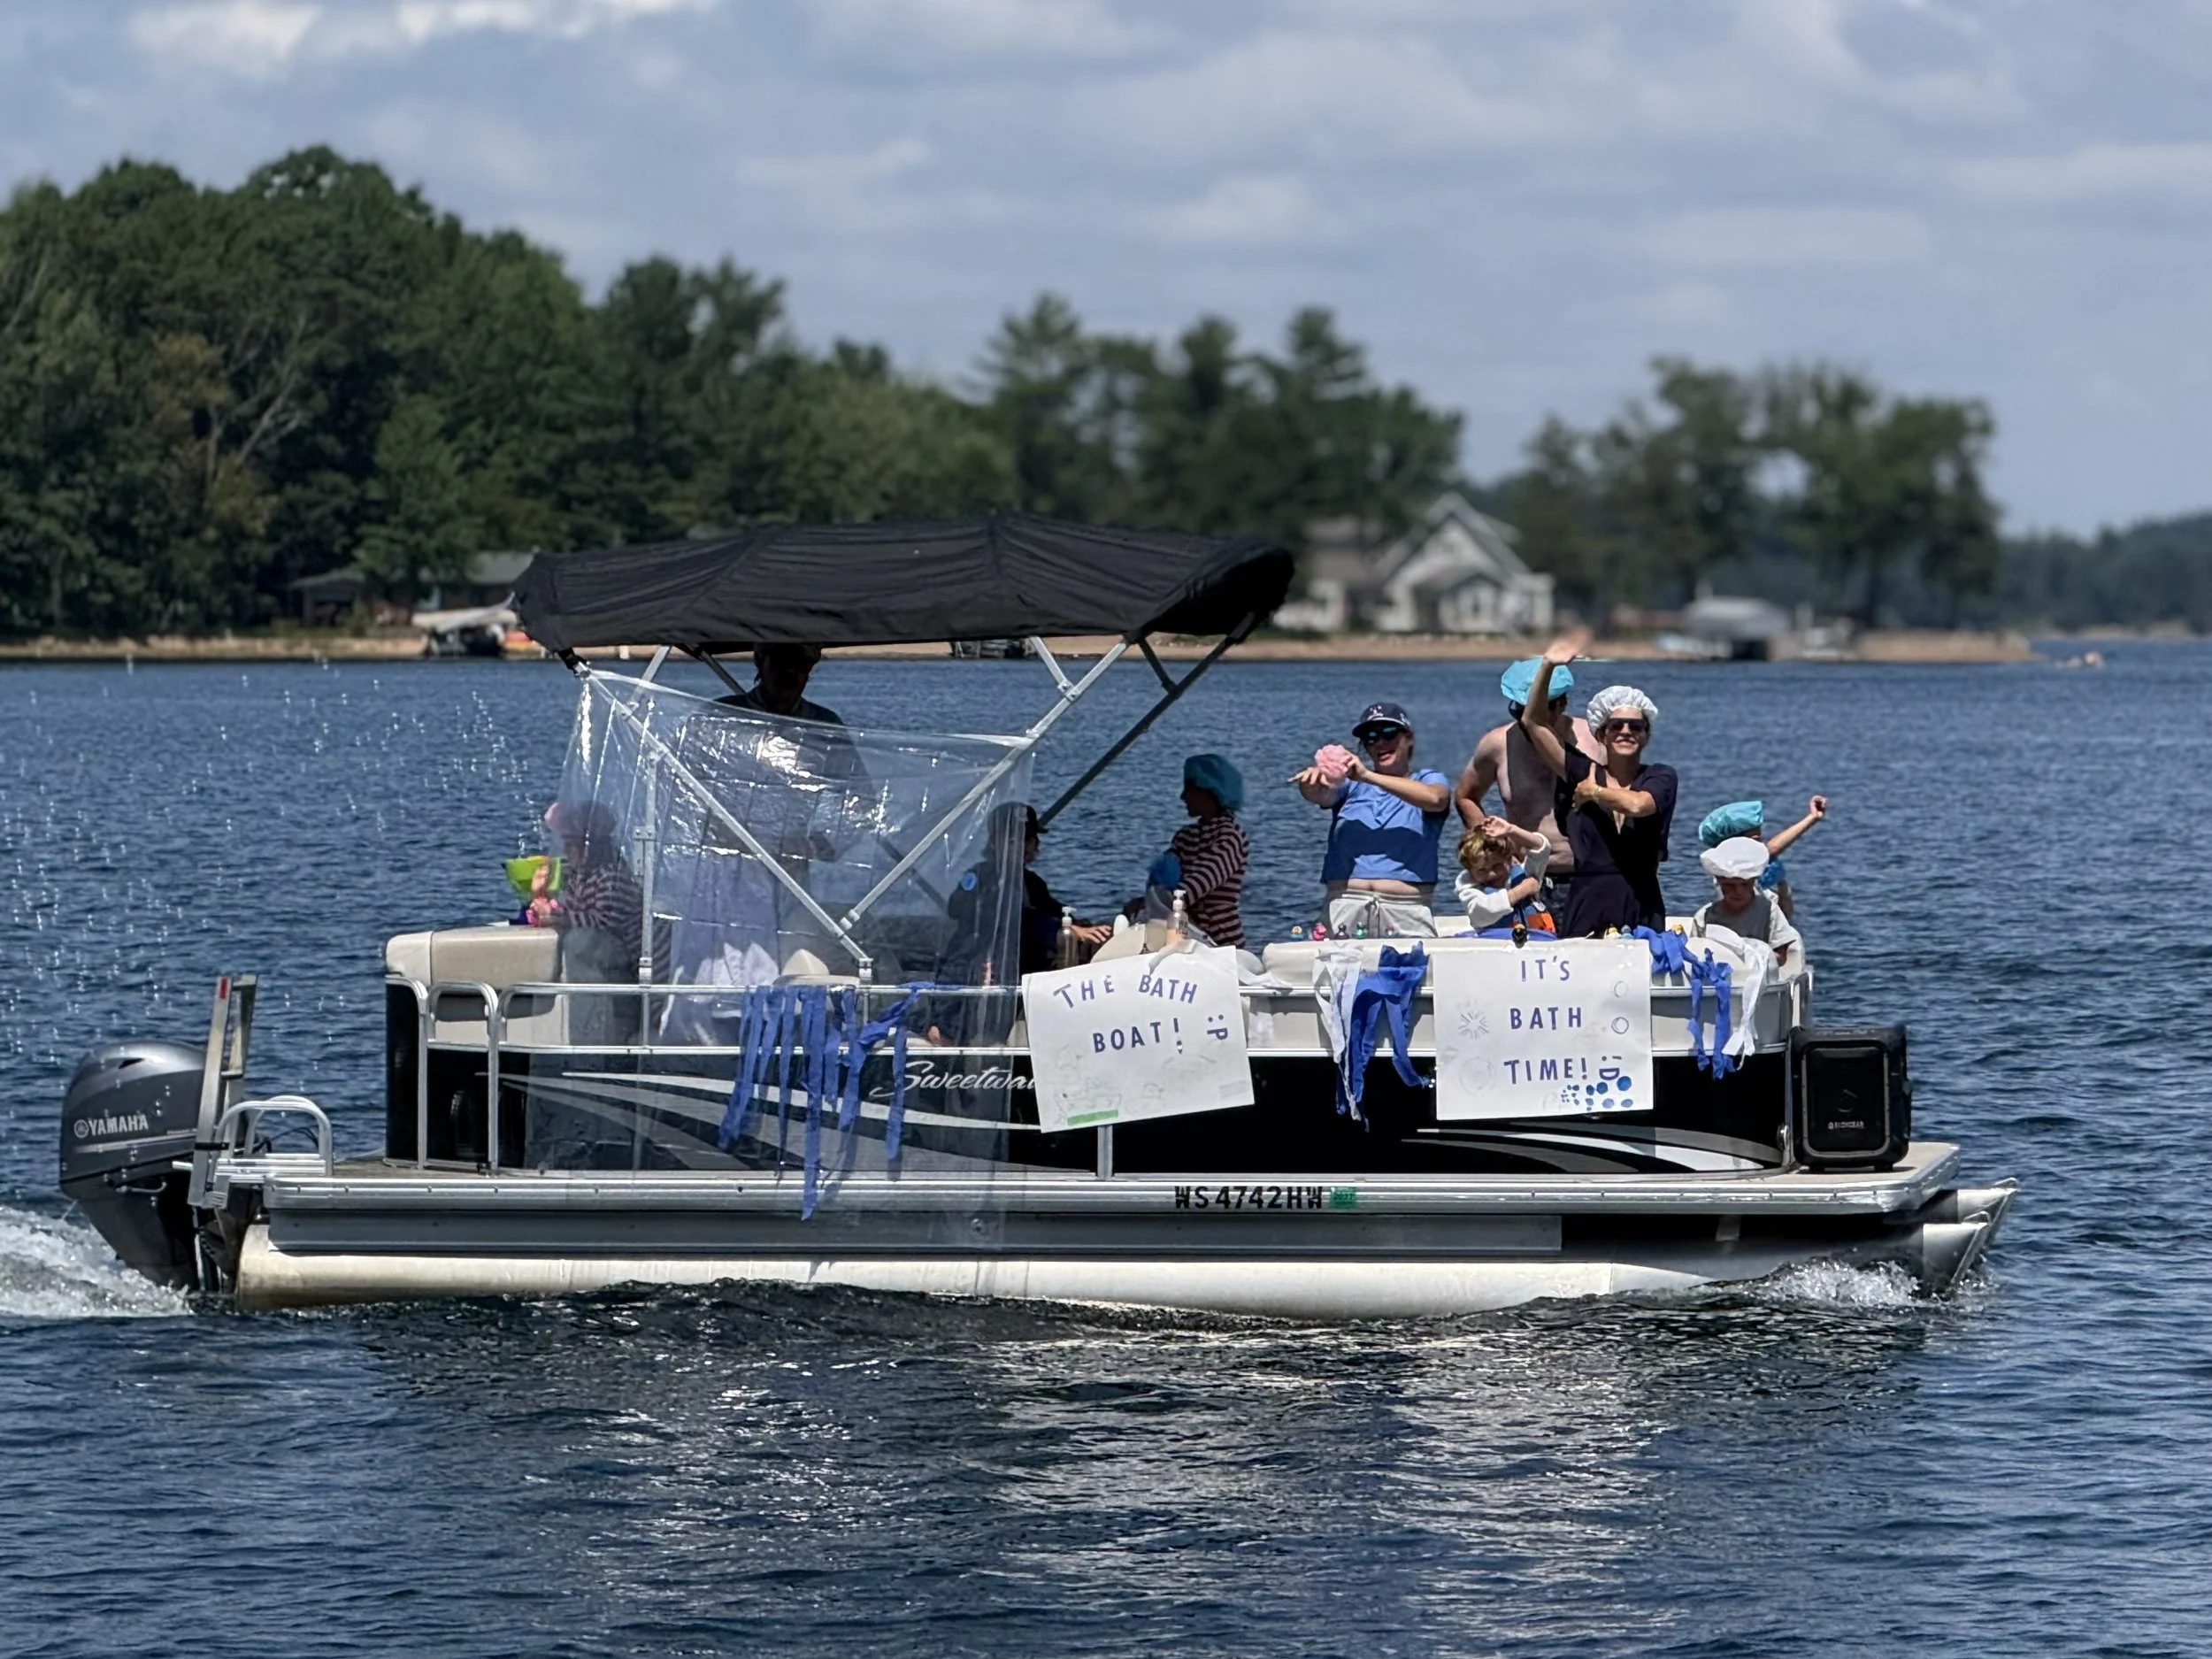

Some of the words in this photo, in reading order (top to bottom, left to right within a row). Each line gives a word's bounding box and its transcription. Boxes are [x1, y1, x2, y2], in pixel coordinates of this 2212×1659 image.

[1520, 956, 1571, 981] IT'S
[1053, 975, 1115, 1009] THE
[1138, 974, 1198, 1004] BATH
[1509, 1007, 1582, 1030] BATH
[1093, 1018, 1184, 1055] BOAT!
[1503, 1057, 1588, 1085] TIME!
[88, 1114, 150, 1136] YAMAHA
